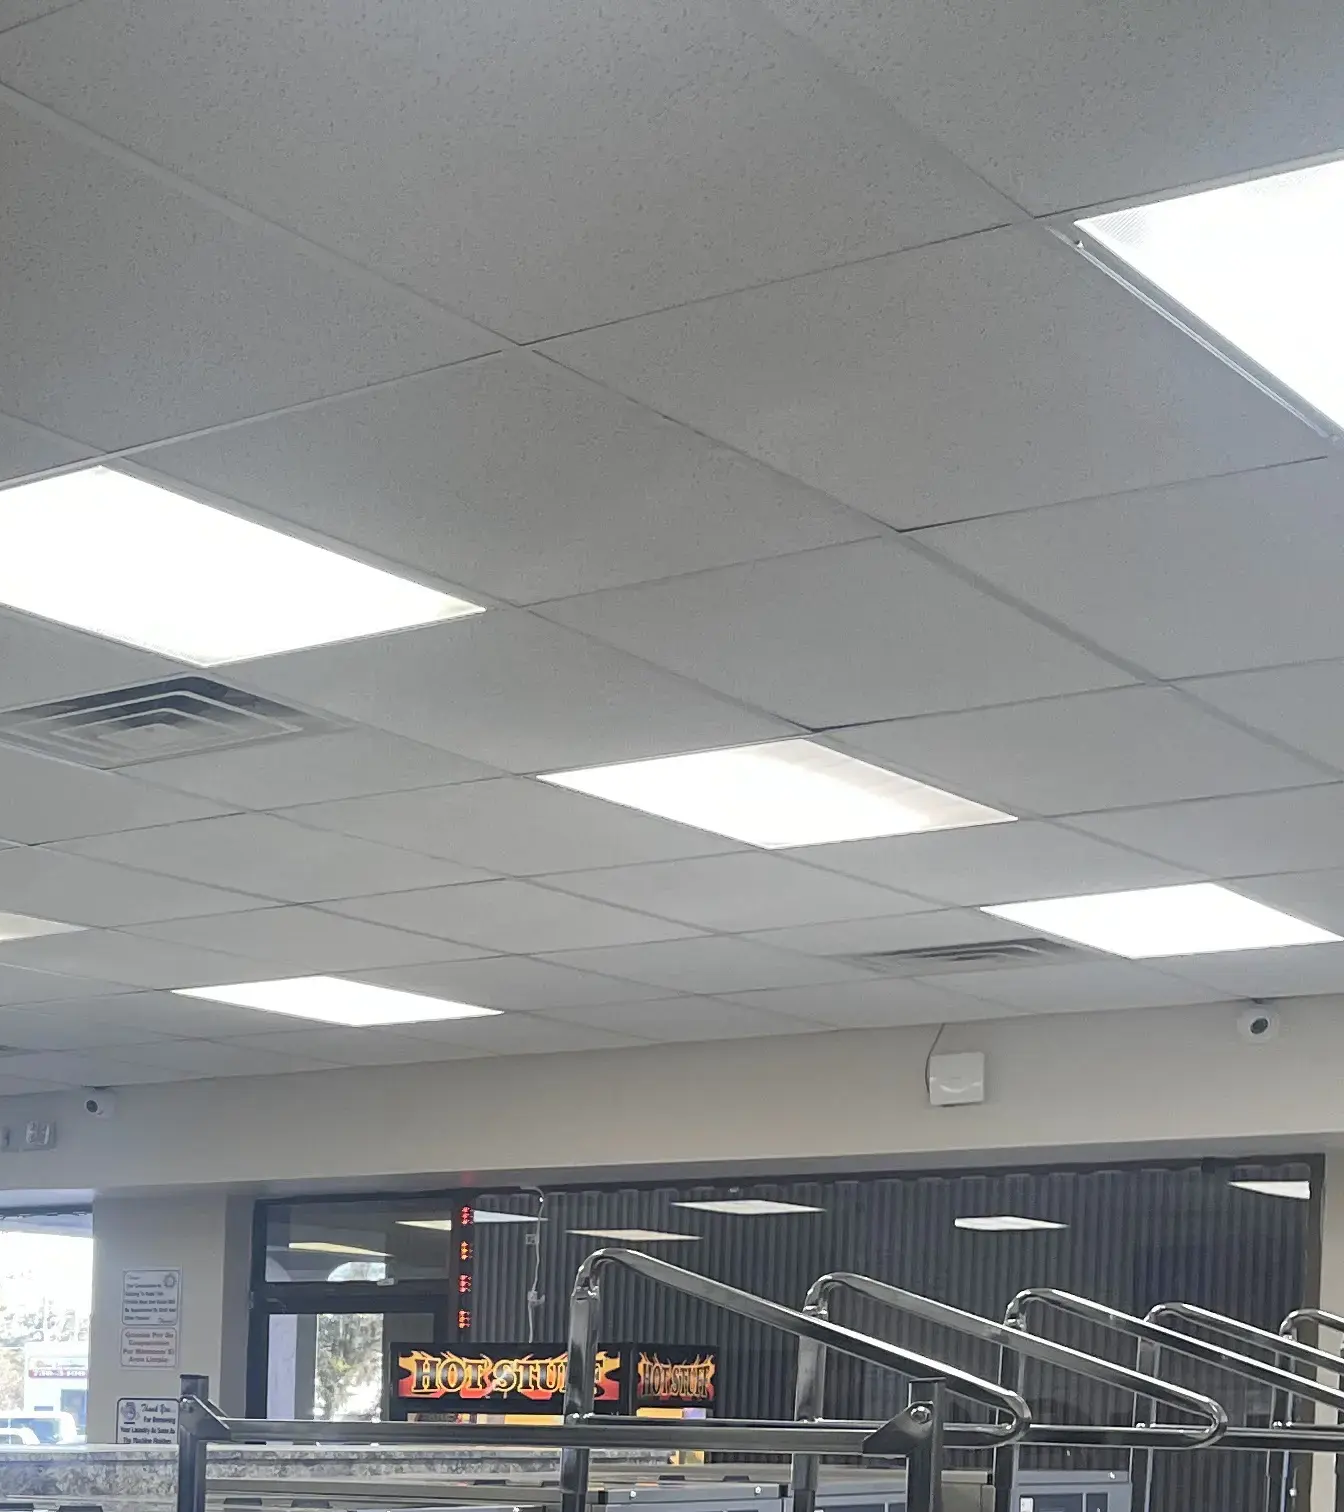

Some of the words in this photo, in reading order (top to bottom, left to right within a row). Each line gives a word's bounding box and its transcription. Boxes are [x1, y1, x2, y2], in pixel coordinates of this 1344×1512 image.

[411, 1357, 485, 1393] HOT
[641, 1362, 671, 1397] HOT
[672, 1364, 711, 1398] STUFF
